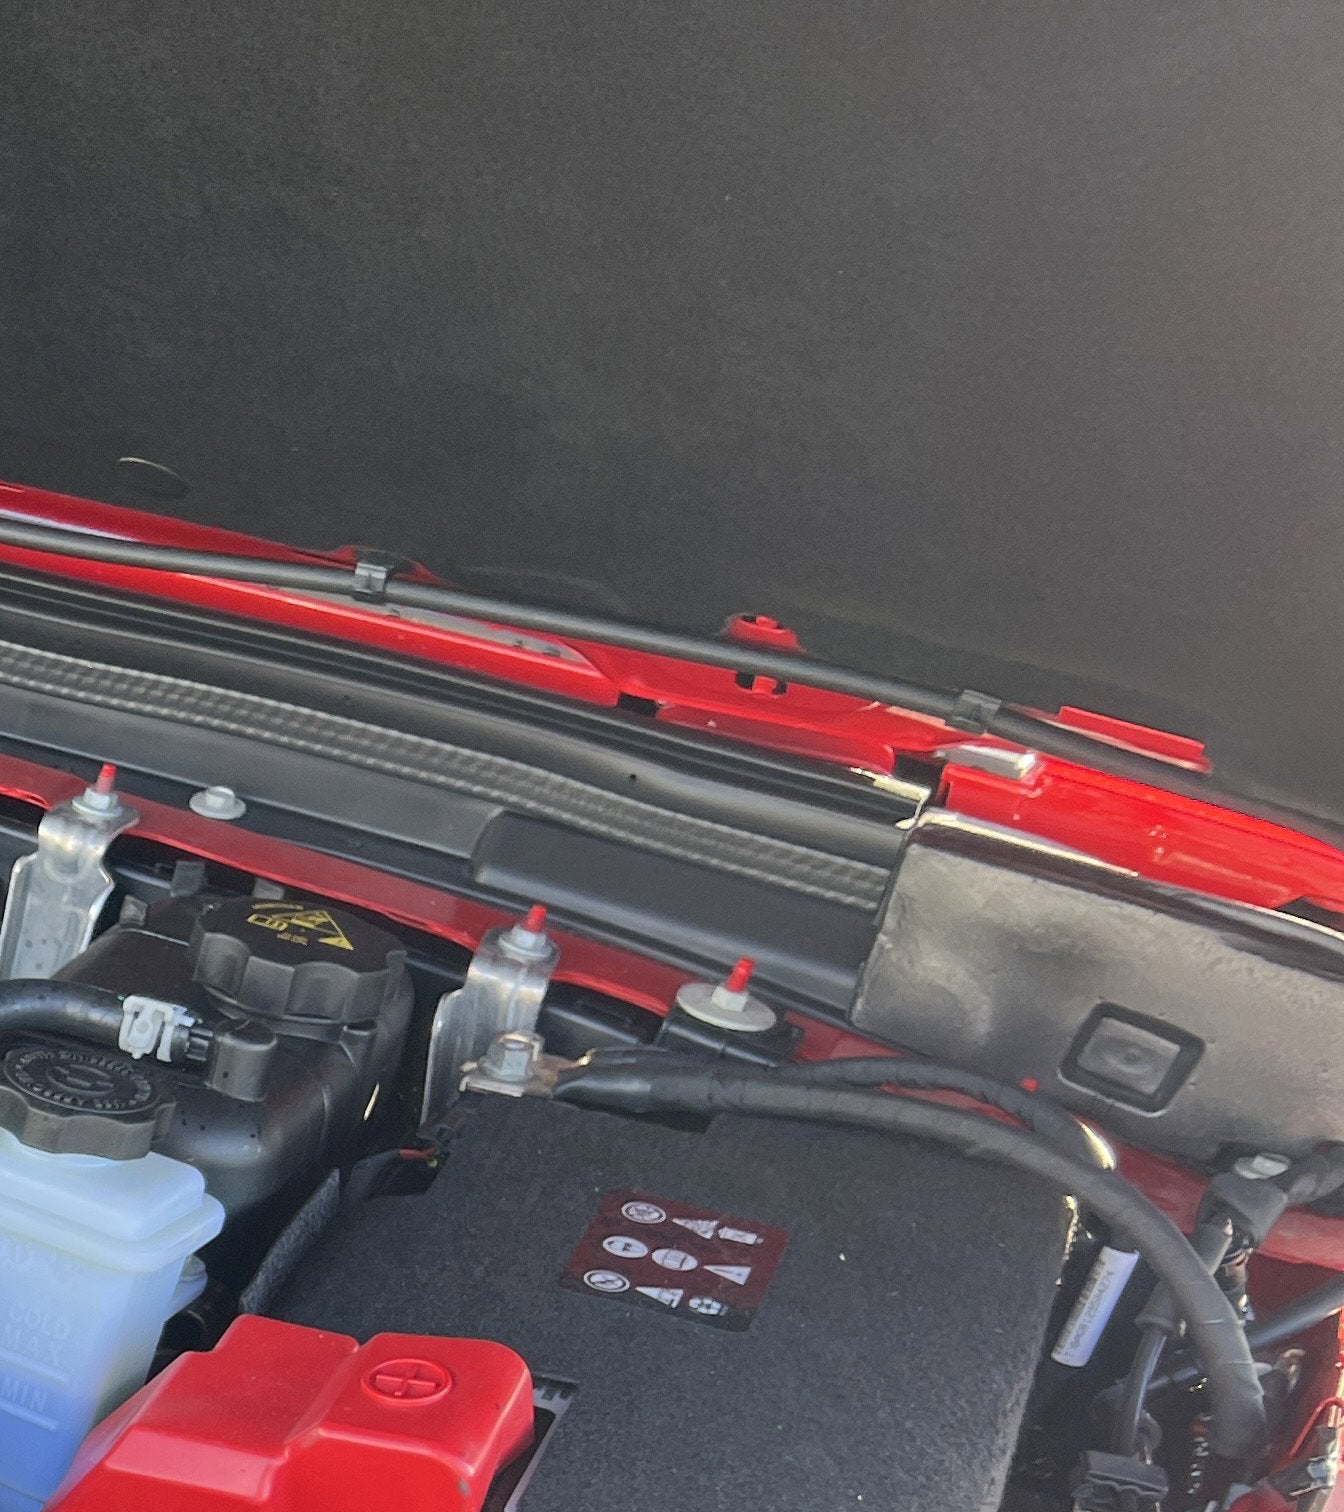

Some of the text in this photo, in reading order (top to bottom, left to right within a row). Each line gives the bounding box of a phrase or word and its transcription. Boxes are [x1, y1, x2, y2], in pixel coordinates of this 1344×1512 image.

[9, 1303, 70, 1339] COLD
[2, 1323, 62, 1366] MAX
[0, 1375, 48, 1411] MIN
